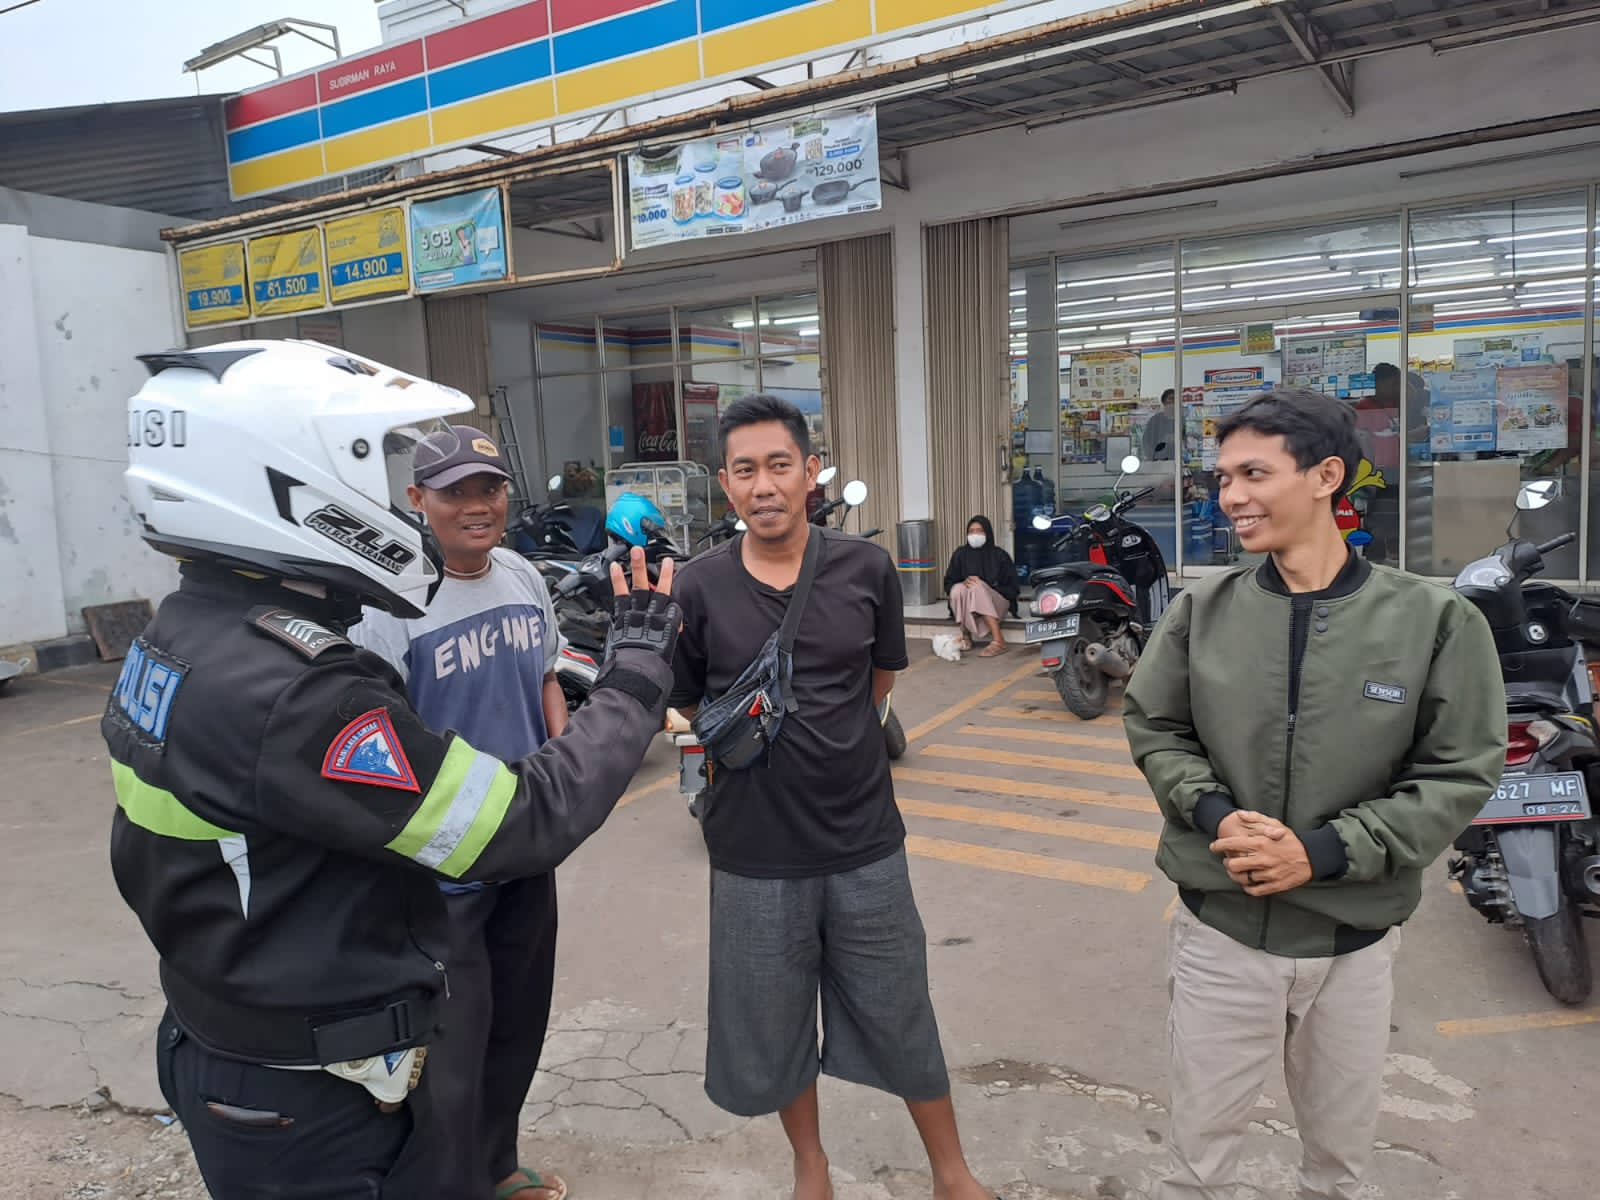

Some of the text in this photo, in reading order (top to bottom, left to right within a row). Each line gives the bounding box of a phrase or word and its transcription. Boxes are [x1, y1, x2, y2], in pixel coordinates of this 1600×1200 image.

[328, 61, 397, 90] SUDIRMAN RAYA
[344, 257, 388, 281] 14.900
[198, 288, 231, 307] 19.900
[309, 517, 354, 545] POLRES
[434, 614, 541, 681] ENGINE
[1489, 779, 1578, 801] 627 MF
